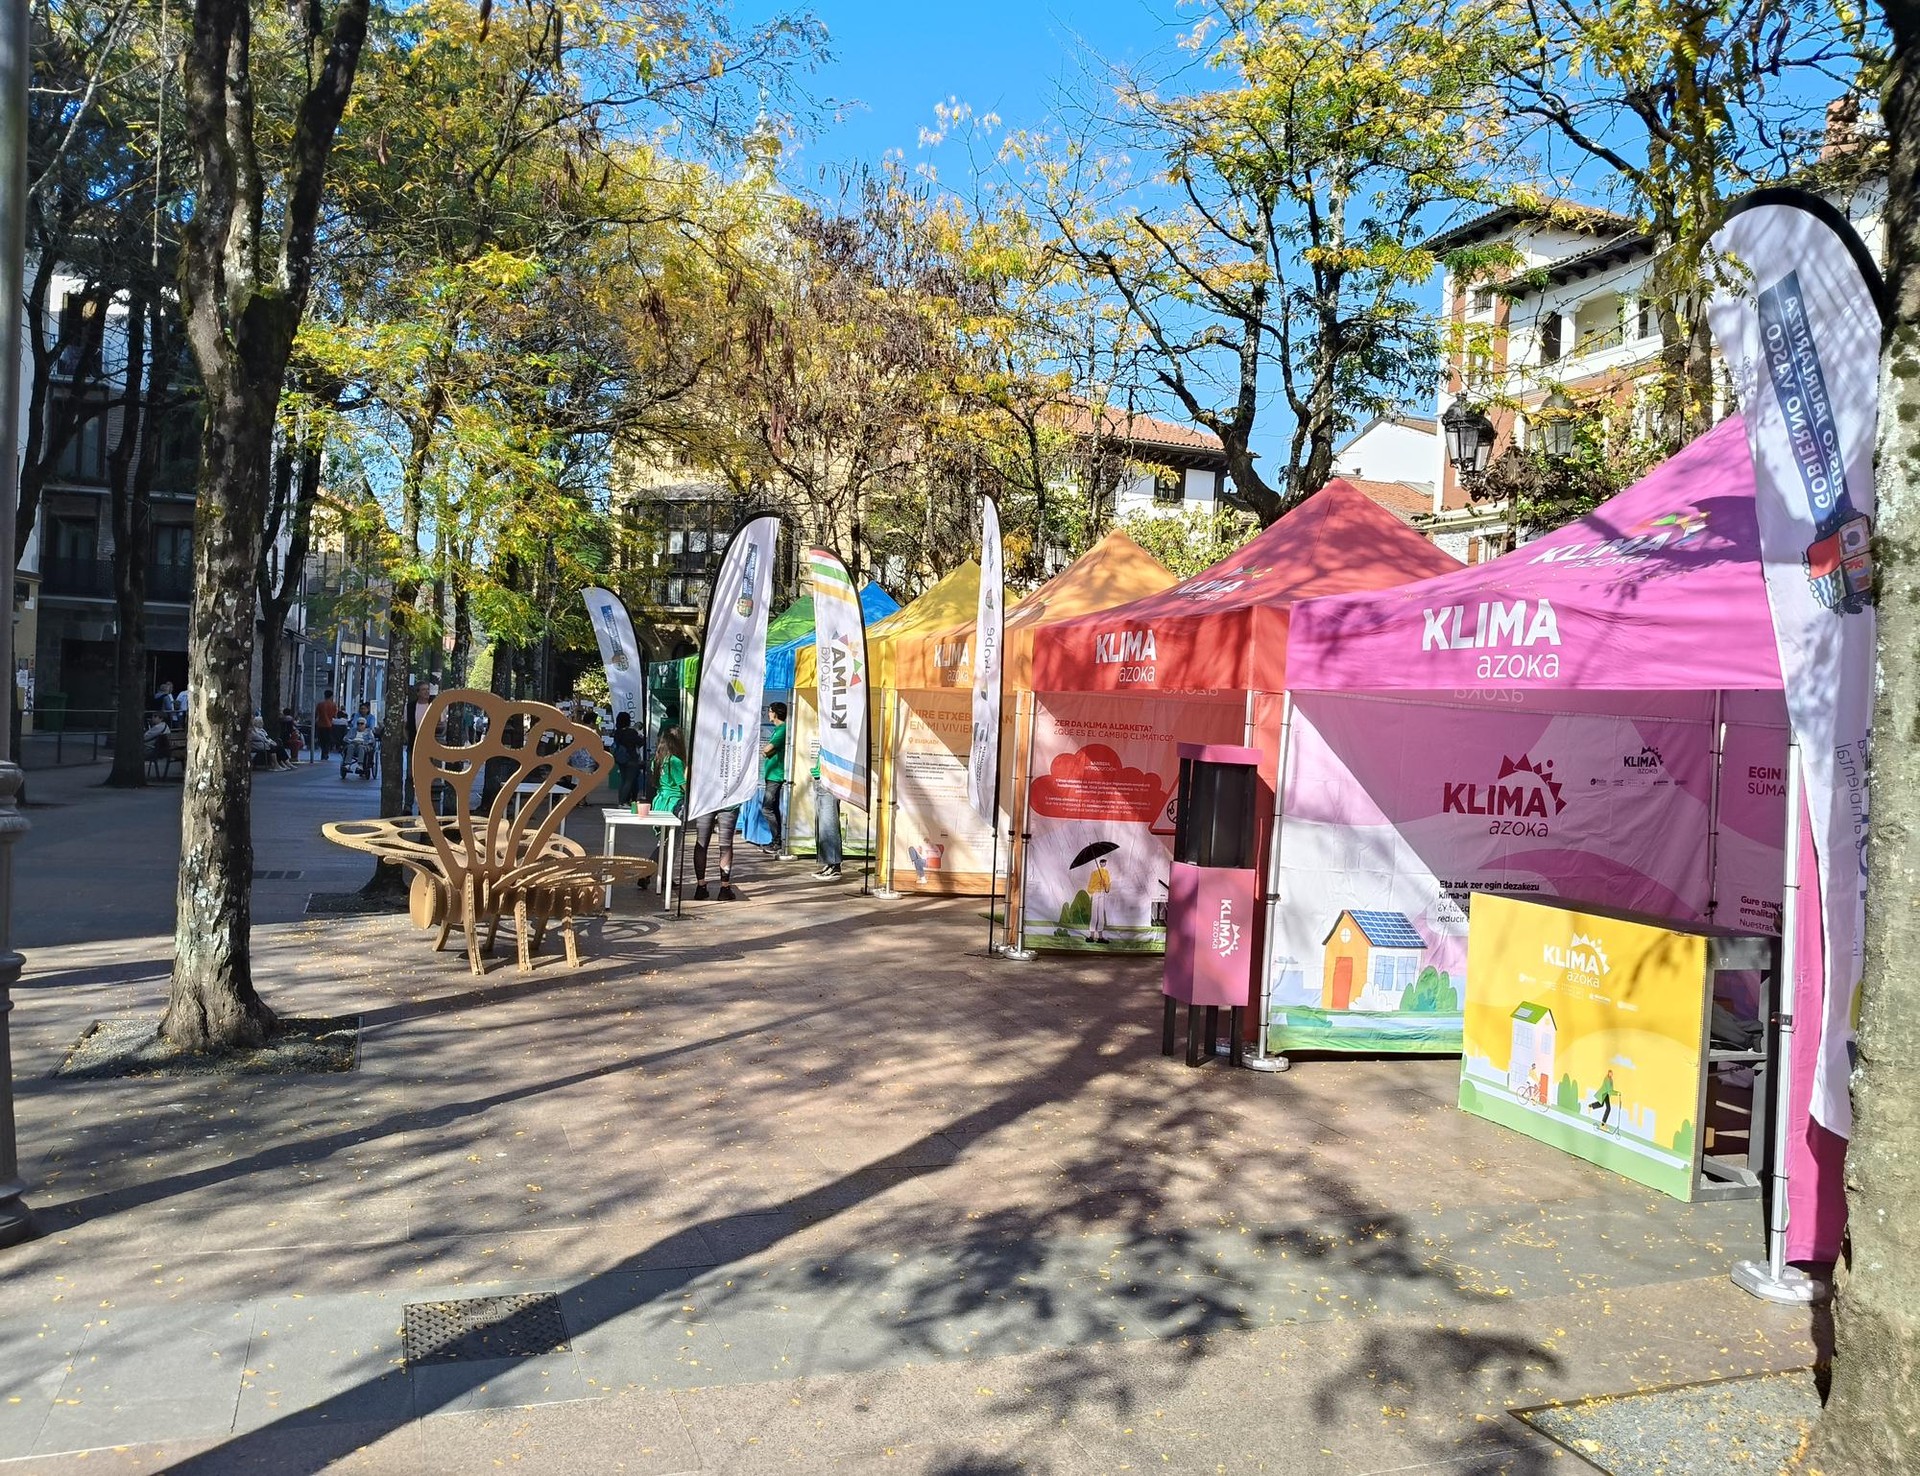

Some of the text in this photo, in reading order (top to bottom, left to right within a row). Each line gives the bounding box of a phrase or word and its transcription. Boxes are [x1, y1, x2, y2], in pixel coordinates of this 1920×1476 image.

[1527, 532, 1672, 565] KLIMA
[1564, 554, 1649, 568] azoka
[1422, 599, 1562, 651] KLIMA
[933, 643, 970, 667] KLIMA
[1095, 630, 1157, 664] KLIMA
[729, 633, 745, 678] ihobe
[1119, 665, 1156, 682] azoka
[1476, 653, 1560, 679] azoka
[910, 721, 924, 730] EN
[928, 722, 939, 731] MI
[1083, 722, 1108, 730] KLIMA
[1087, 730, 1096, 738] EL
[1098, 731, 1129, 740] CAMBIO
[1623, 756, 1657, 768] KLIMA
[1749, 766, 1781, 780] EGIN
[1443, 782, 1547, 818] KLIMA
[1489, 820, 1549, 837] azoka
[1440, 880, 1540, 891] Eta zuk zer egin dezakezu
[1741, 896, 1760, 906] Gure
[1219, 899, 1232, 949] KLIMA
[1437, 915, 1464, 923] reducir
[1740, 919, 1774, 932] Nuestras
[1543, 944, 1600, 976] KLIMA
[1567, 972, 1600, 988] azoka
